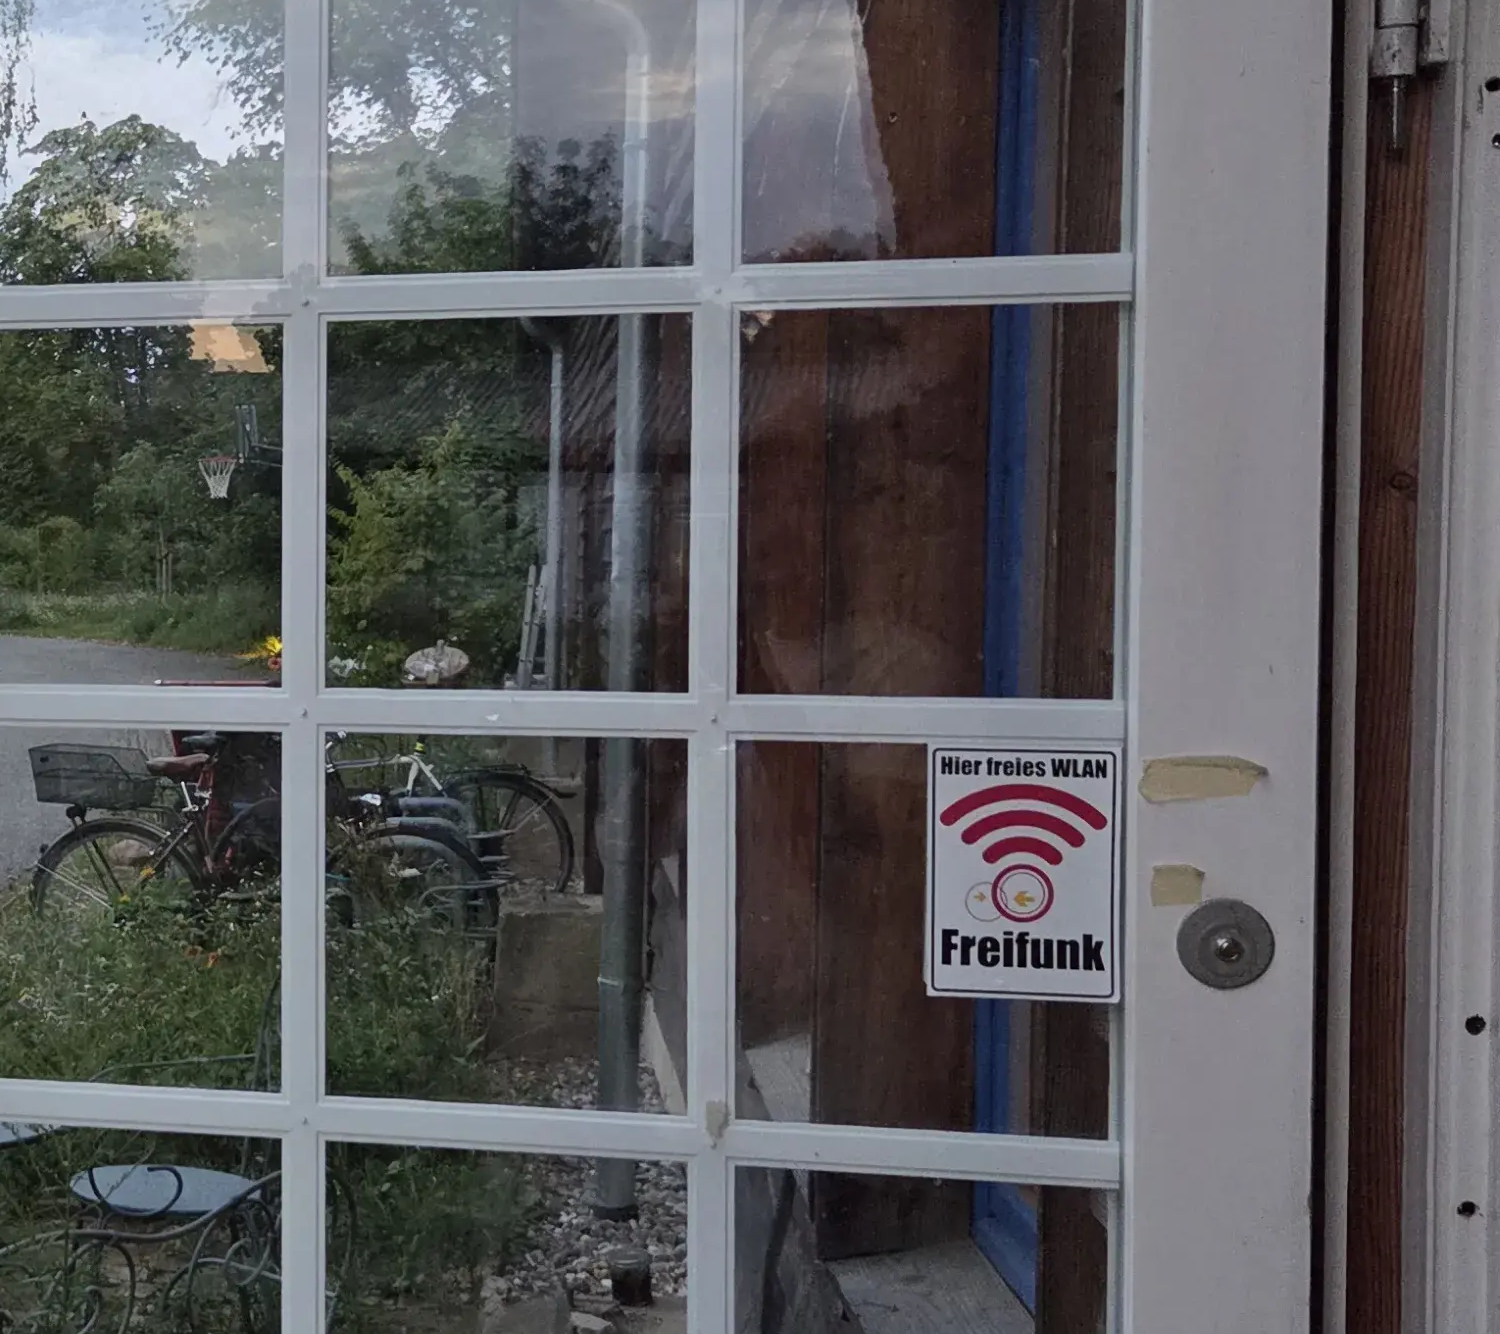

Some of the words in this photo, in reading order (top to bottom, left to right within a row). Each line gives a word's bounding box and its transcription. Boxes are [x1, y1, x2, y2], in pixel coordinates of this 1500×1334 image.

[940, 756, 981, 776] Hier
[986, 757, 1046, 777] freies
[1051, 758, 1108, 778] WLAN
[941, 929, 1105, 971] Freifunk
